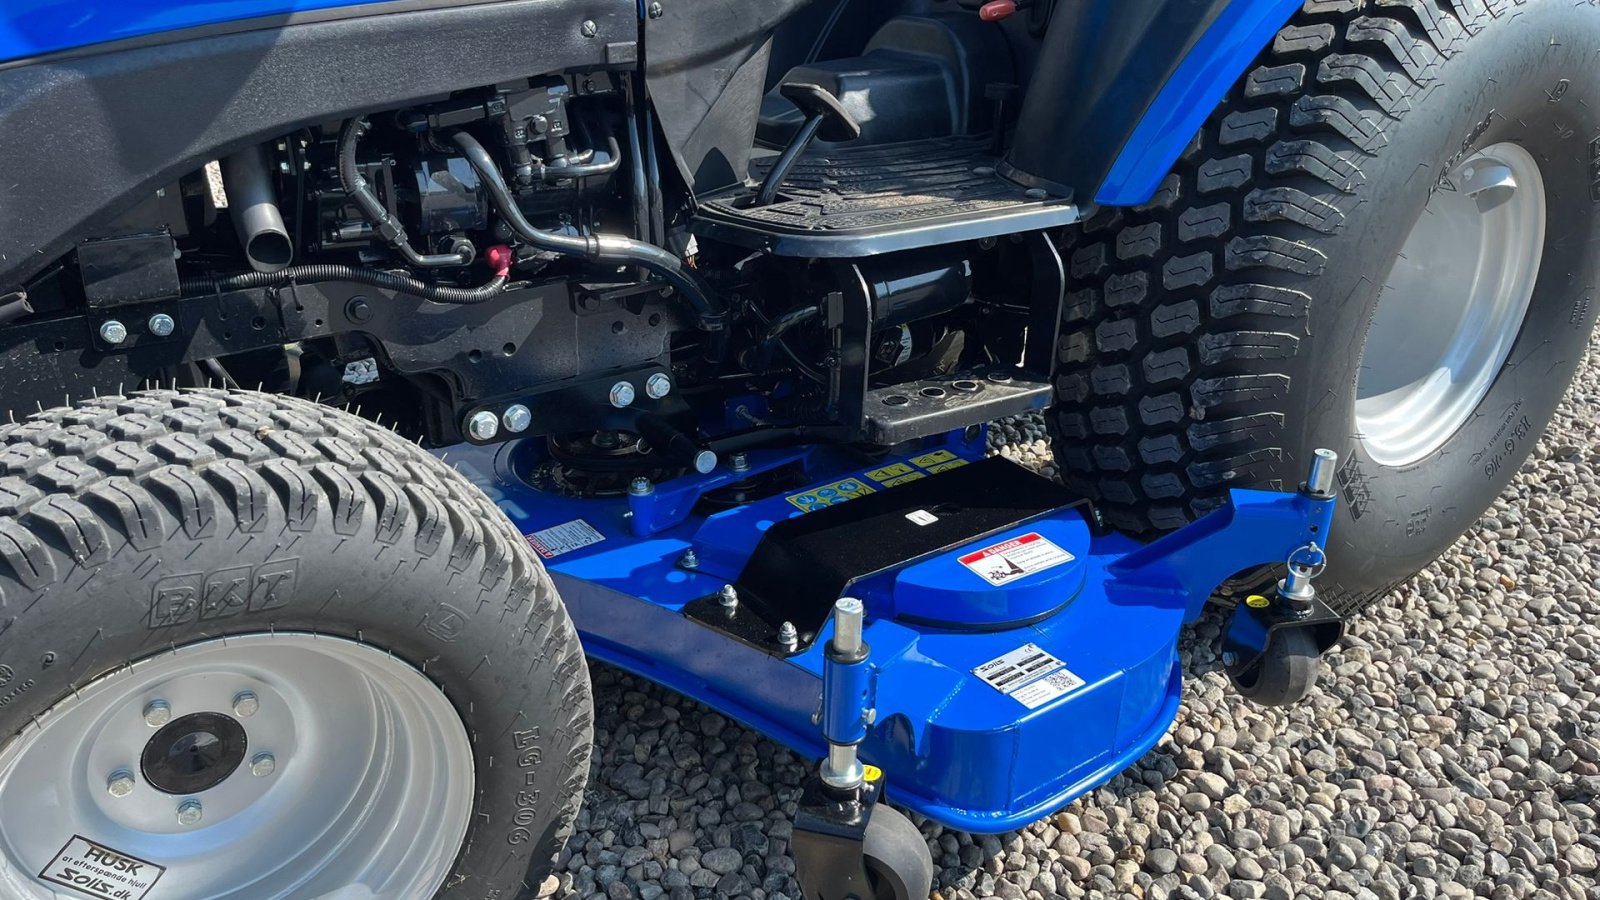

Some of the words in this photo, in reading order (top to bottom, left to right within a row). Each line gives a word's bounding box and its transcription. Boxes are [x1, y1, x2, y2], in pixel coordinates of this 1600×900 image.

[988, 540, 1023, 555] DANGER
[154, 567, 295, 621] BKT
[507, 726, 542, 845] LG-306
[62, 855, 73, 863] at
[73, 860, 127, 882] efterspænde
[84, 846, 143, 876] HUSK
